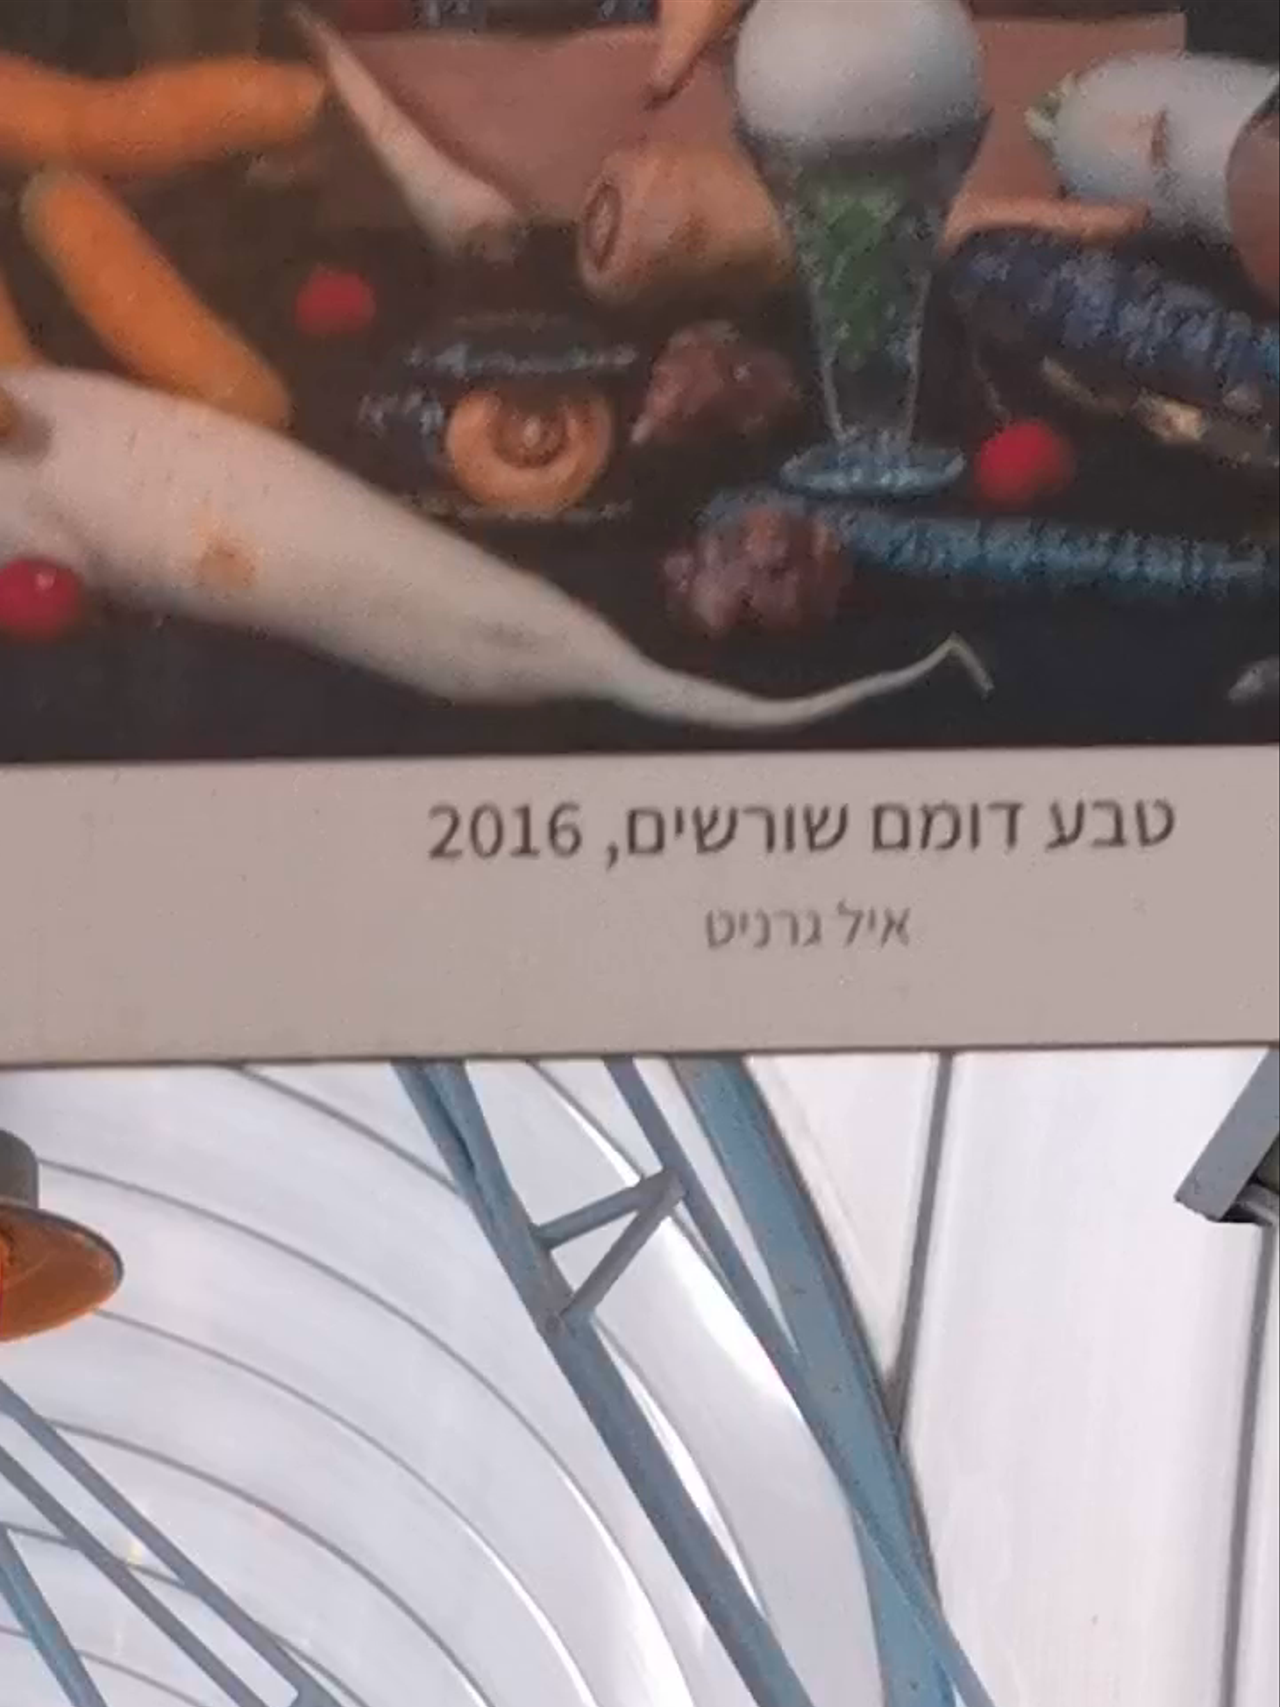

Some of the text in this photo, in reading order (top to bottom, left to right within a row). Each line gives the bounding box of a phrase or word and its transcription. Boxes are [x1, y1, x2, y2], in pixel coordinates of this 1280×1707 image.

[428, 800, 1175, 869] טבע דומם שורשים, 2016
[706, 899, 911, 949] איל גרניט
